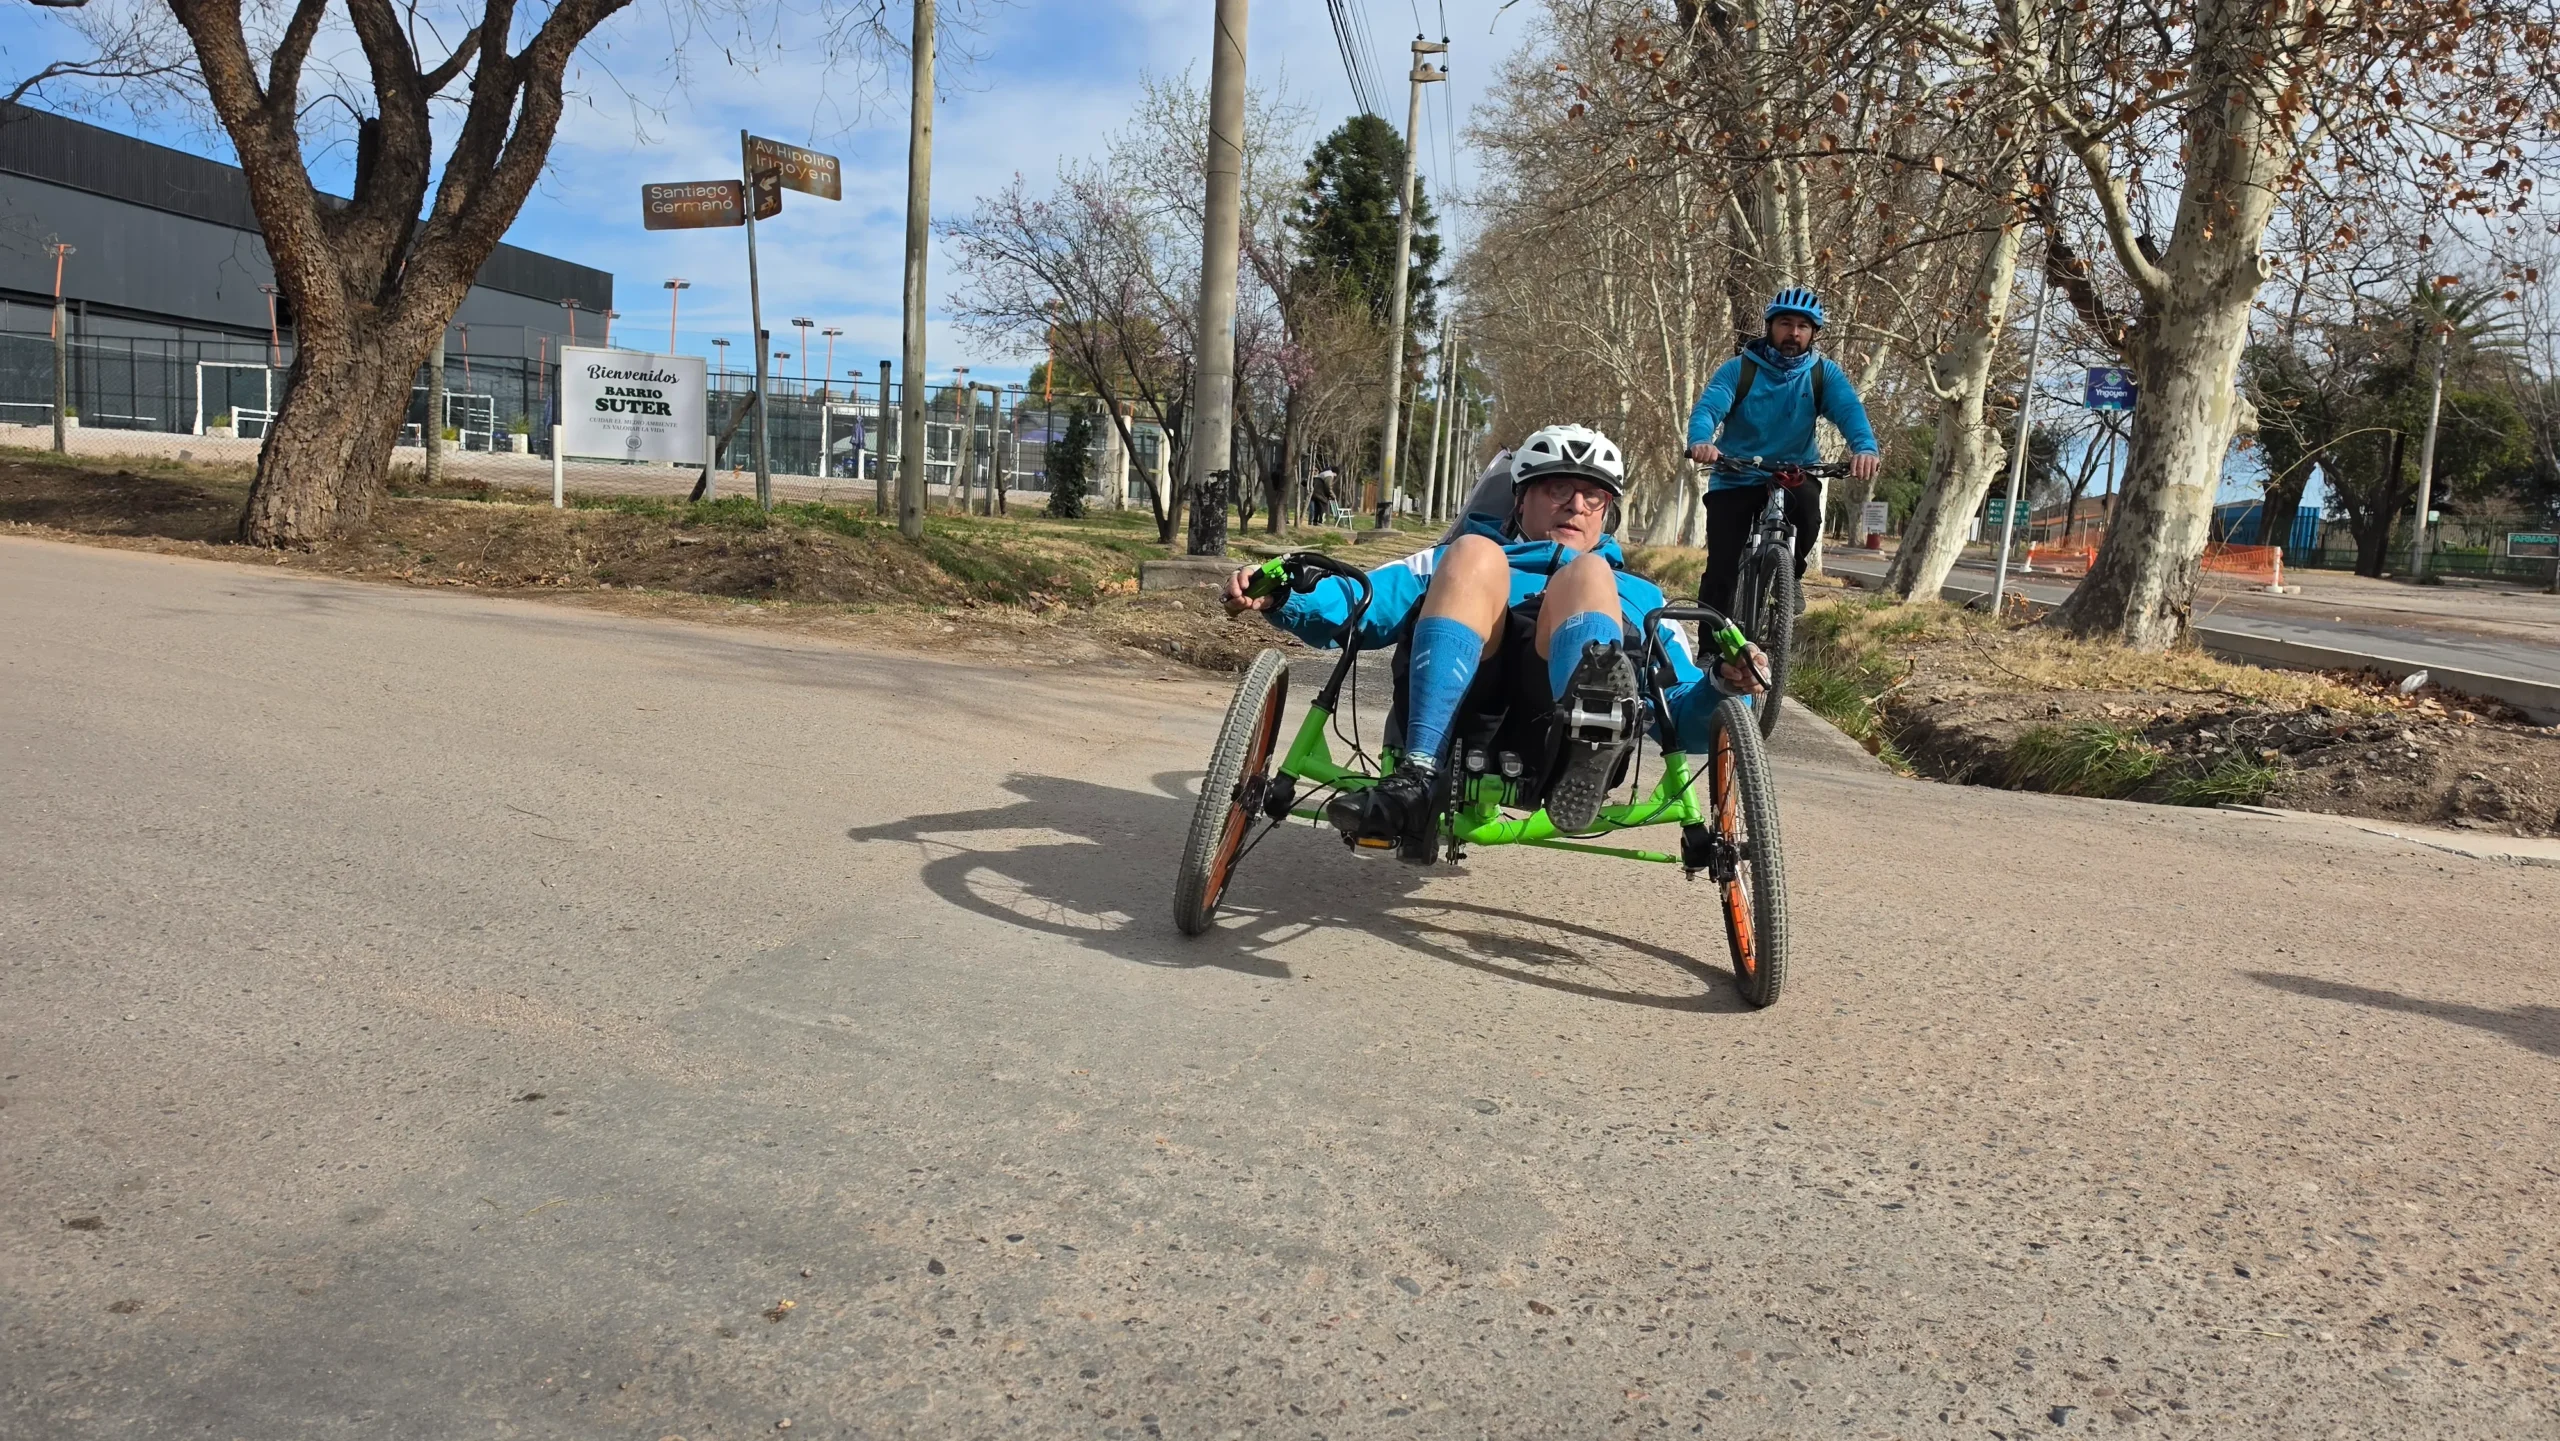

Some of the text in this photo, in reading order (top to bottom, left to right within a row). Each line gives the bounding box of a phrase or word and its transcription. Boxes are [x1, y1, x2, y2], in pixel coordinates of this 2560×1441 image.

[777, 144, 835, 170] Hipolito
[651, 185, 728, 199] Santiago
[651, 196, 734, 214] Germanó
[587, 364, 681, 384] Bienvenidos
[605, 386, 663, 399] BARRIO
[595, 398, 672, 417] SUTER
[645, 420, 678, 428] AMBIENTE
[2509, 535, 2558, 544] FARMACIA
